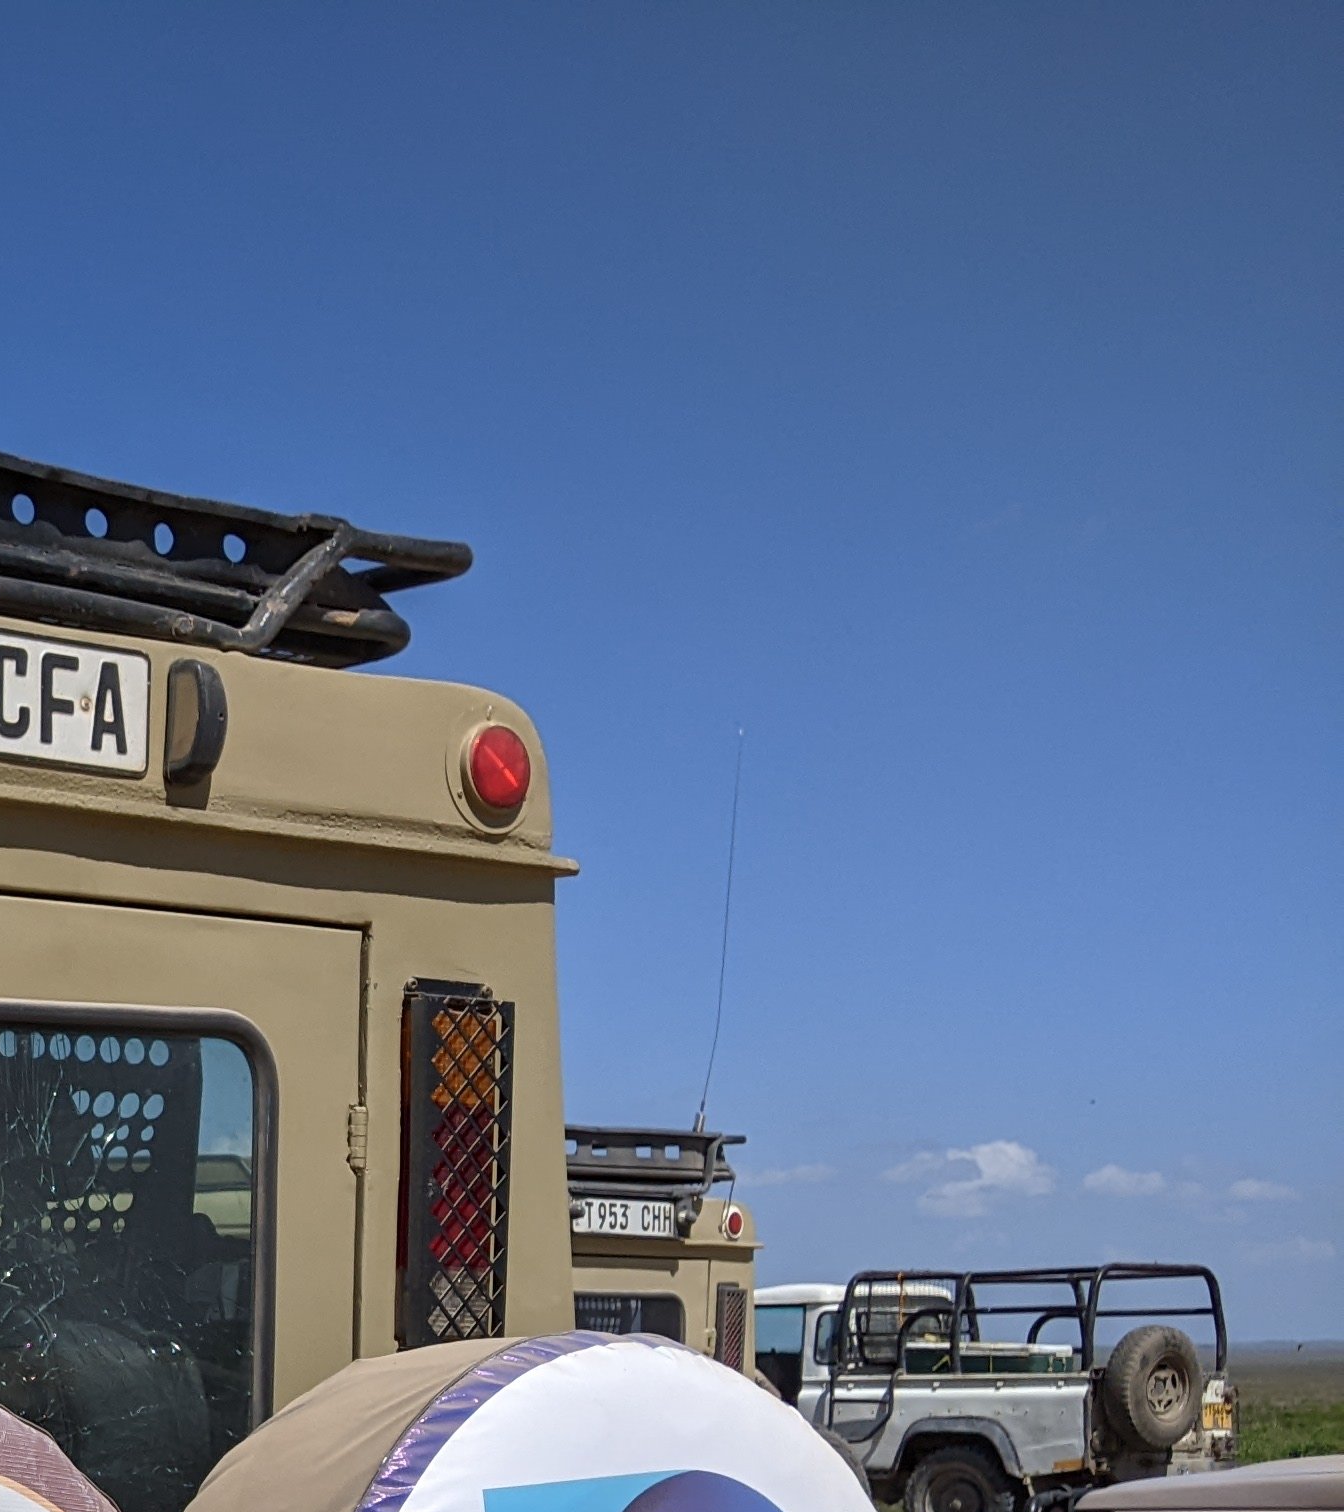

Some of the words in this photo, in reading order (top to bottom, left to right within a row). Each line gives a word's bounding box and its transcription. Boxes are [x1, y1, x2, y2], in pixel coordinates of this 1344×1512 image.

[584, 1201, 594, 1229] T
[598, 1202, 629, 1230] 953
[641, 1204, 672, 1233] CHH
